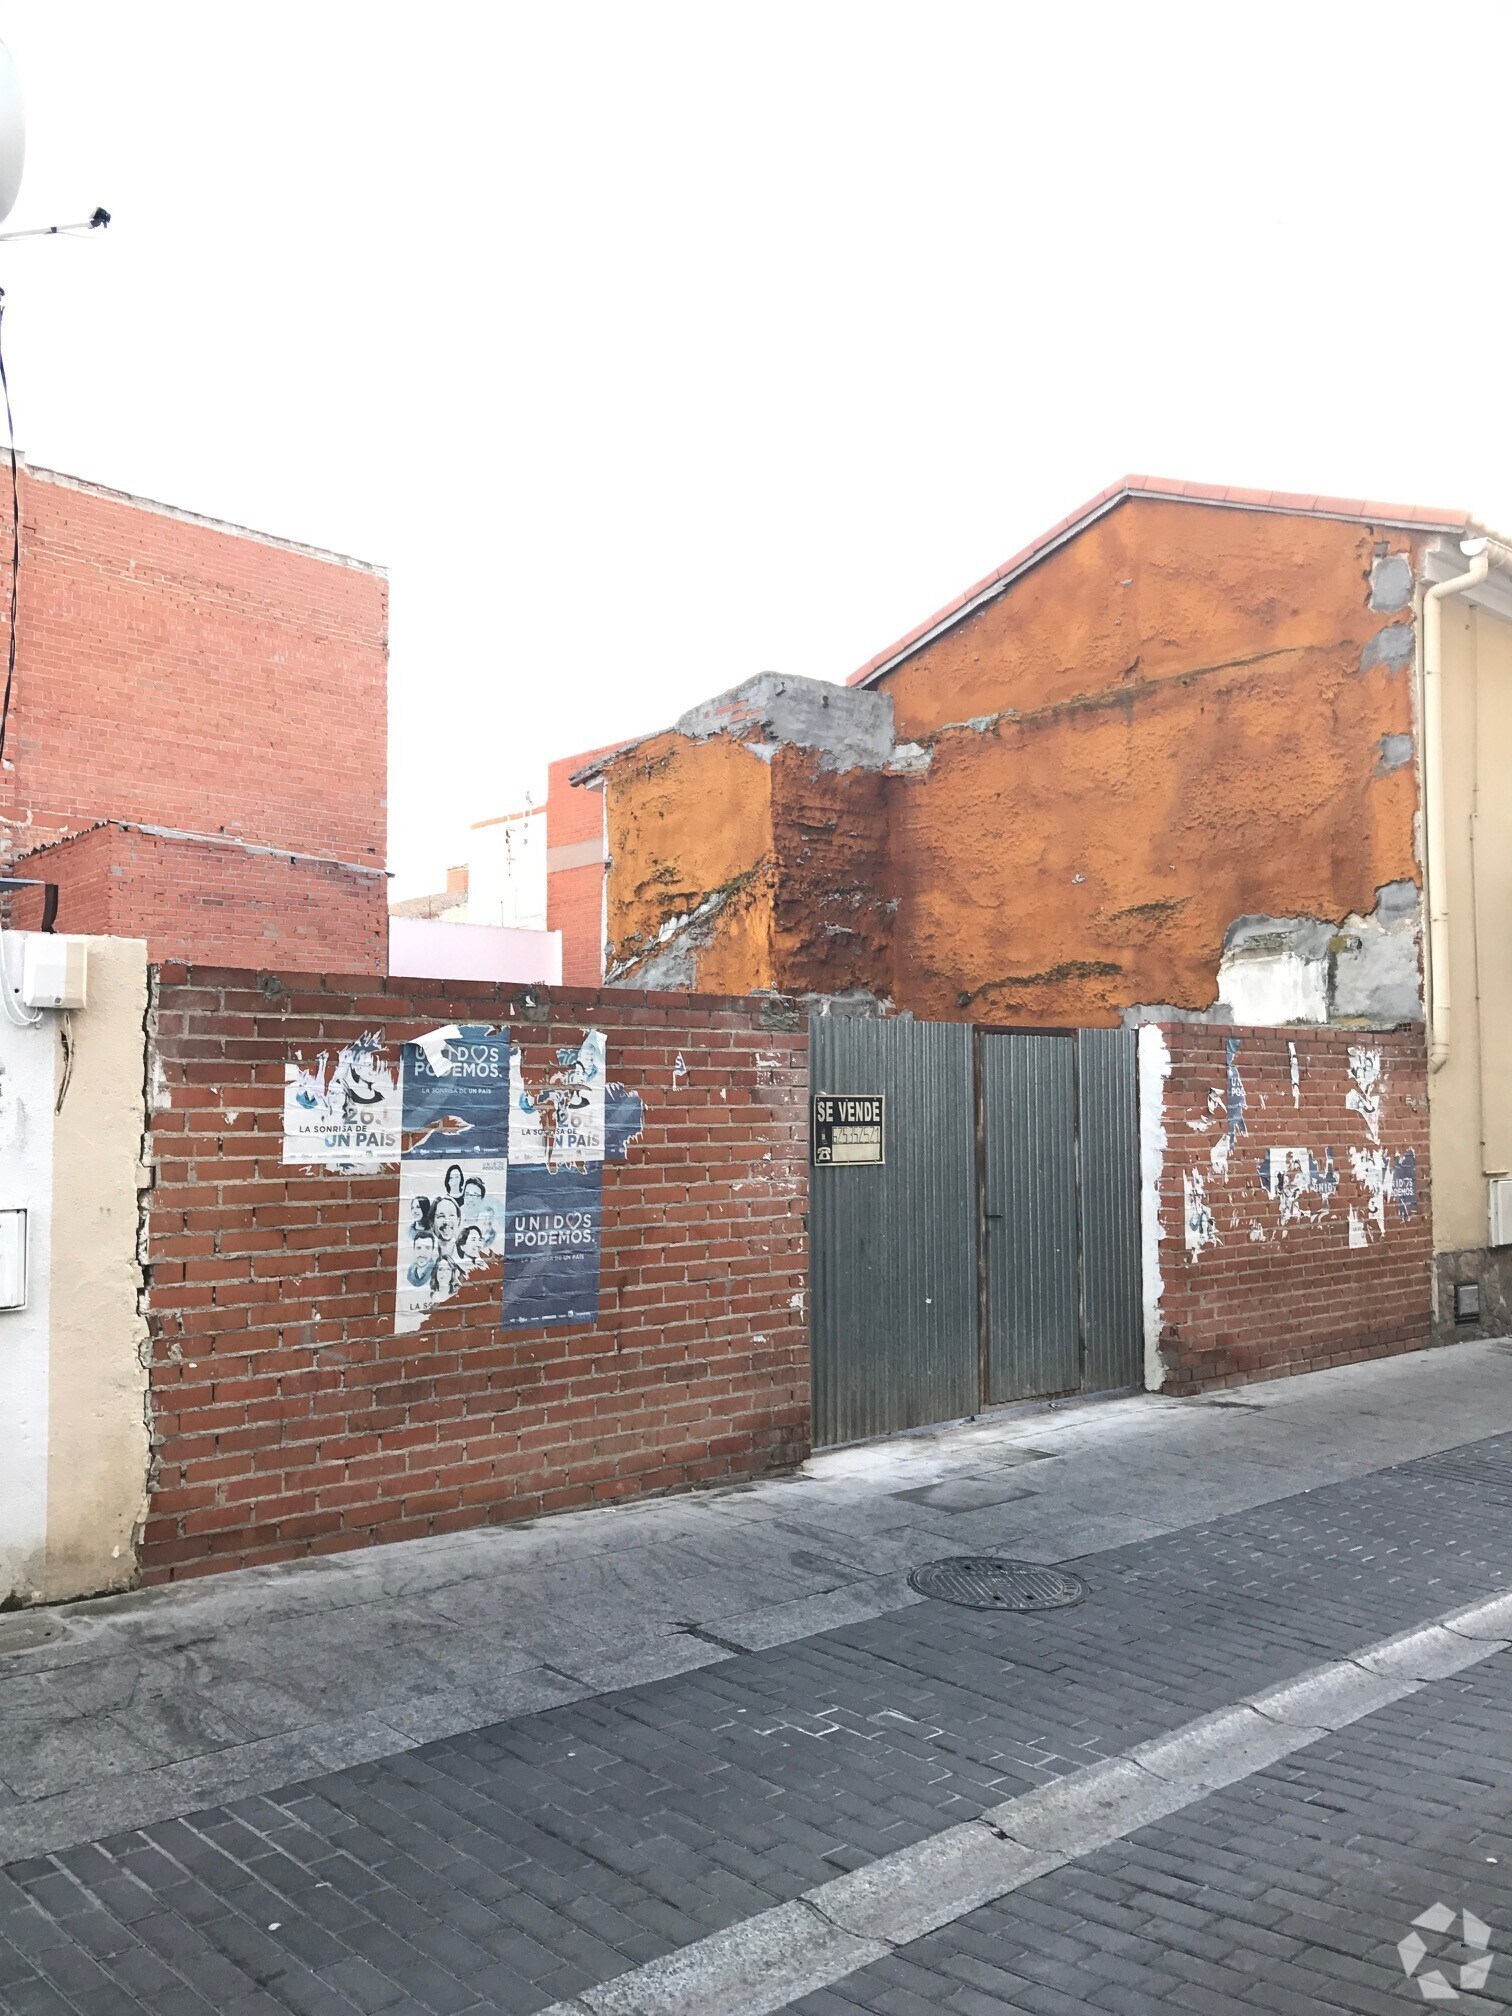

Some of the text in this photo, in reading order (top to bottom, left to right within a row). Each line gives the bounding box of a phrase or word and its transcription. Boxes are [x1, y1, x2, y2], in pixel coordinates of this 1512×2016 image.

[415, 1045, 499, 1063] UIDOS
[414, 1061, 503, 1078] POEMOS.
[817, 1100, 880, 1122] SE VENDE
[299, 1125, 311, 1133] LA
[314, 1125, 353, 1133] SONRISA
[324, 1130, 396, 1147] UN PAÍS
[567, 1132, 600, 1148] PAÍS
[515, 1212, 592, 1231] UNIDOS
[514, 1229, 595, 1247] PODEMOS.
[409, 1302, 420, 1310] LA
